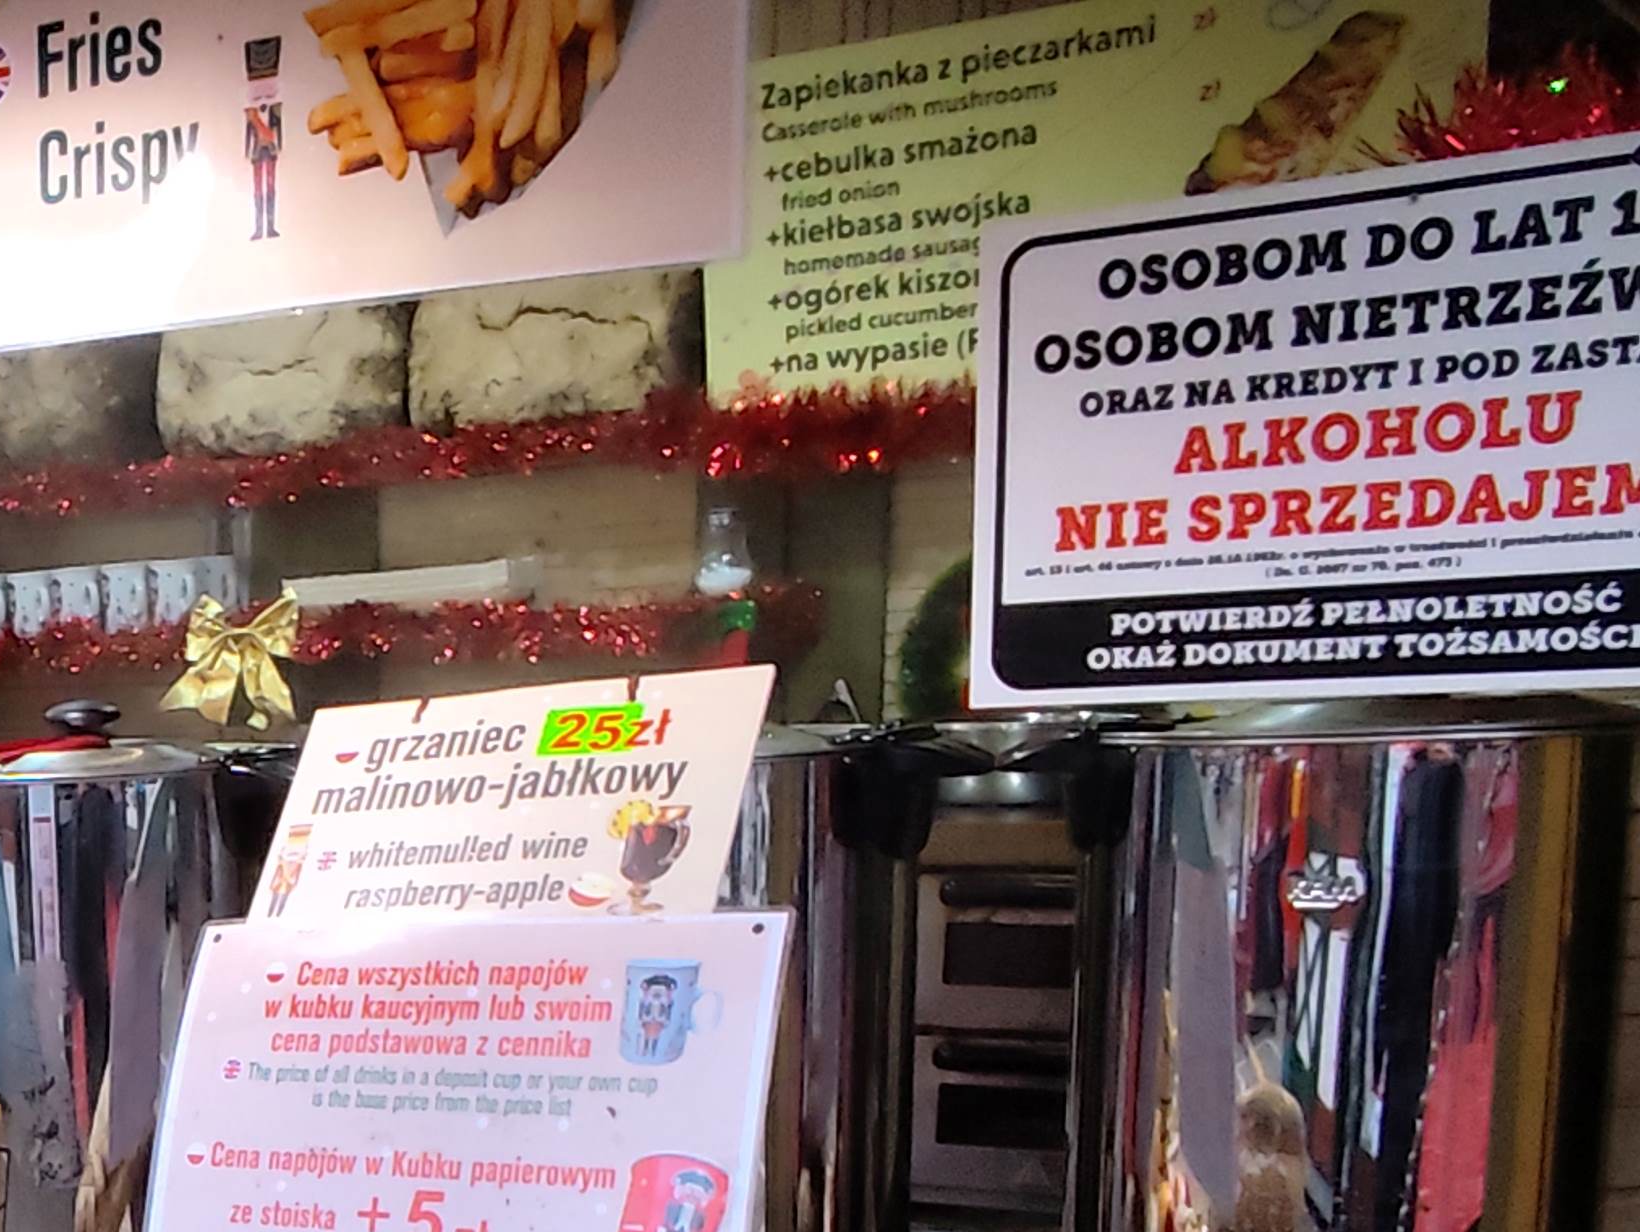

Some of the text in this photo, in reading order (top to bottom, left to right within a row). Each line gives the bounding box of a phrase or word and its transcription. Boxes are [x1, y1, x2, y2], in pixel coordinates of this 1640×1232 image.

[36, 11, 163, 99] Fries
[760, 59, 928, 111] Zapiekanka
[937, 58, 952, 80] z
[961, 14, 1156, 83] pieczarkami
[761, 79, 1058, 143] Casserole with mushrooms
[38, 120, 201, 205] Crispy
[763, 122, 1038, 183] +cebulka smażona
[765, 192, 1031, 248] +kiełbasa swojska
[781, 179, 901, 212] fried onion
[783, 246, 905, 276] homemade
[1100, 229, 1347, 299] OSOBOM
[1367, 216, 1454, 267] DO
[1471, 195, 1595, 253] LAT
[768, 272, 889, 316] +ogórek
[784, 316, 862, 344] pickled
[826, 333, 948, 374] wypasie
[1034, 308, 1273, 373] OSOBOM
[1079, 335, 1640, 418] ORAZ NA KREDYT I POD ZAST
[1174, 390, 1582, 476] ALKOHOLU
[1054, 498, 1170, 553] NIE
[1110, 581, 1623, 637] POTWIERDŹ PEŁNOLETNOŚĆ
[1086, 637, 1176, 671] OKAŻ
[1183, 633, 1386, 667] DOKUMENT
[365, 707, 671, 773] grzaniec 25zł
[311, 757, 688, 817] malinowo-jabłkowy
[348, 830, 589, 871] whitemulled wine
[344, 873, 565, 911] raspberry-apple
[296, 959, 589, 991] Cena wszystkich napojów
[263, 993, 613, 1027] w kubku kaucyjnym lub swoim
[270, 1028, 593, 1060] cena podstawowa z cennika
[248, 1062, 271, 1082] The
[276, 1064, 311, 1085] price
[315, 1065, 329, 1083] of
[354, 1066, 397, 1086] drinks
[402, 1069, 416, 1085] in
[420, 1073, 429, 1086] a
[493, 1075, 522, 1092] cup
[527, 1075, 543, 1089] or
[547, 1076, 583, 1095] your
[588, 1077, 622, 1093] own
[627, 1078, 658, 1097] cup
[328, 1090, 350, 1108] the
[392, 1094, 429, 1113] price
[435, 1092, 470, 1112] from
[475, 1094, 498, 1114] the
[503, 1097, 543, 1117] price
[210, 1140, 260, 1169] Cena
[365, 1156, 382, 1176] w
[391, 1150, 461, 1180] Kubku
[470, 1159, 616, 1190] papierowym
[230, 1204, 252, 1224] ze
[260, 1200, 336, 1230] stoiska
